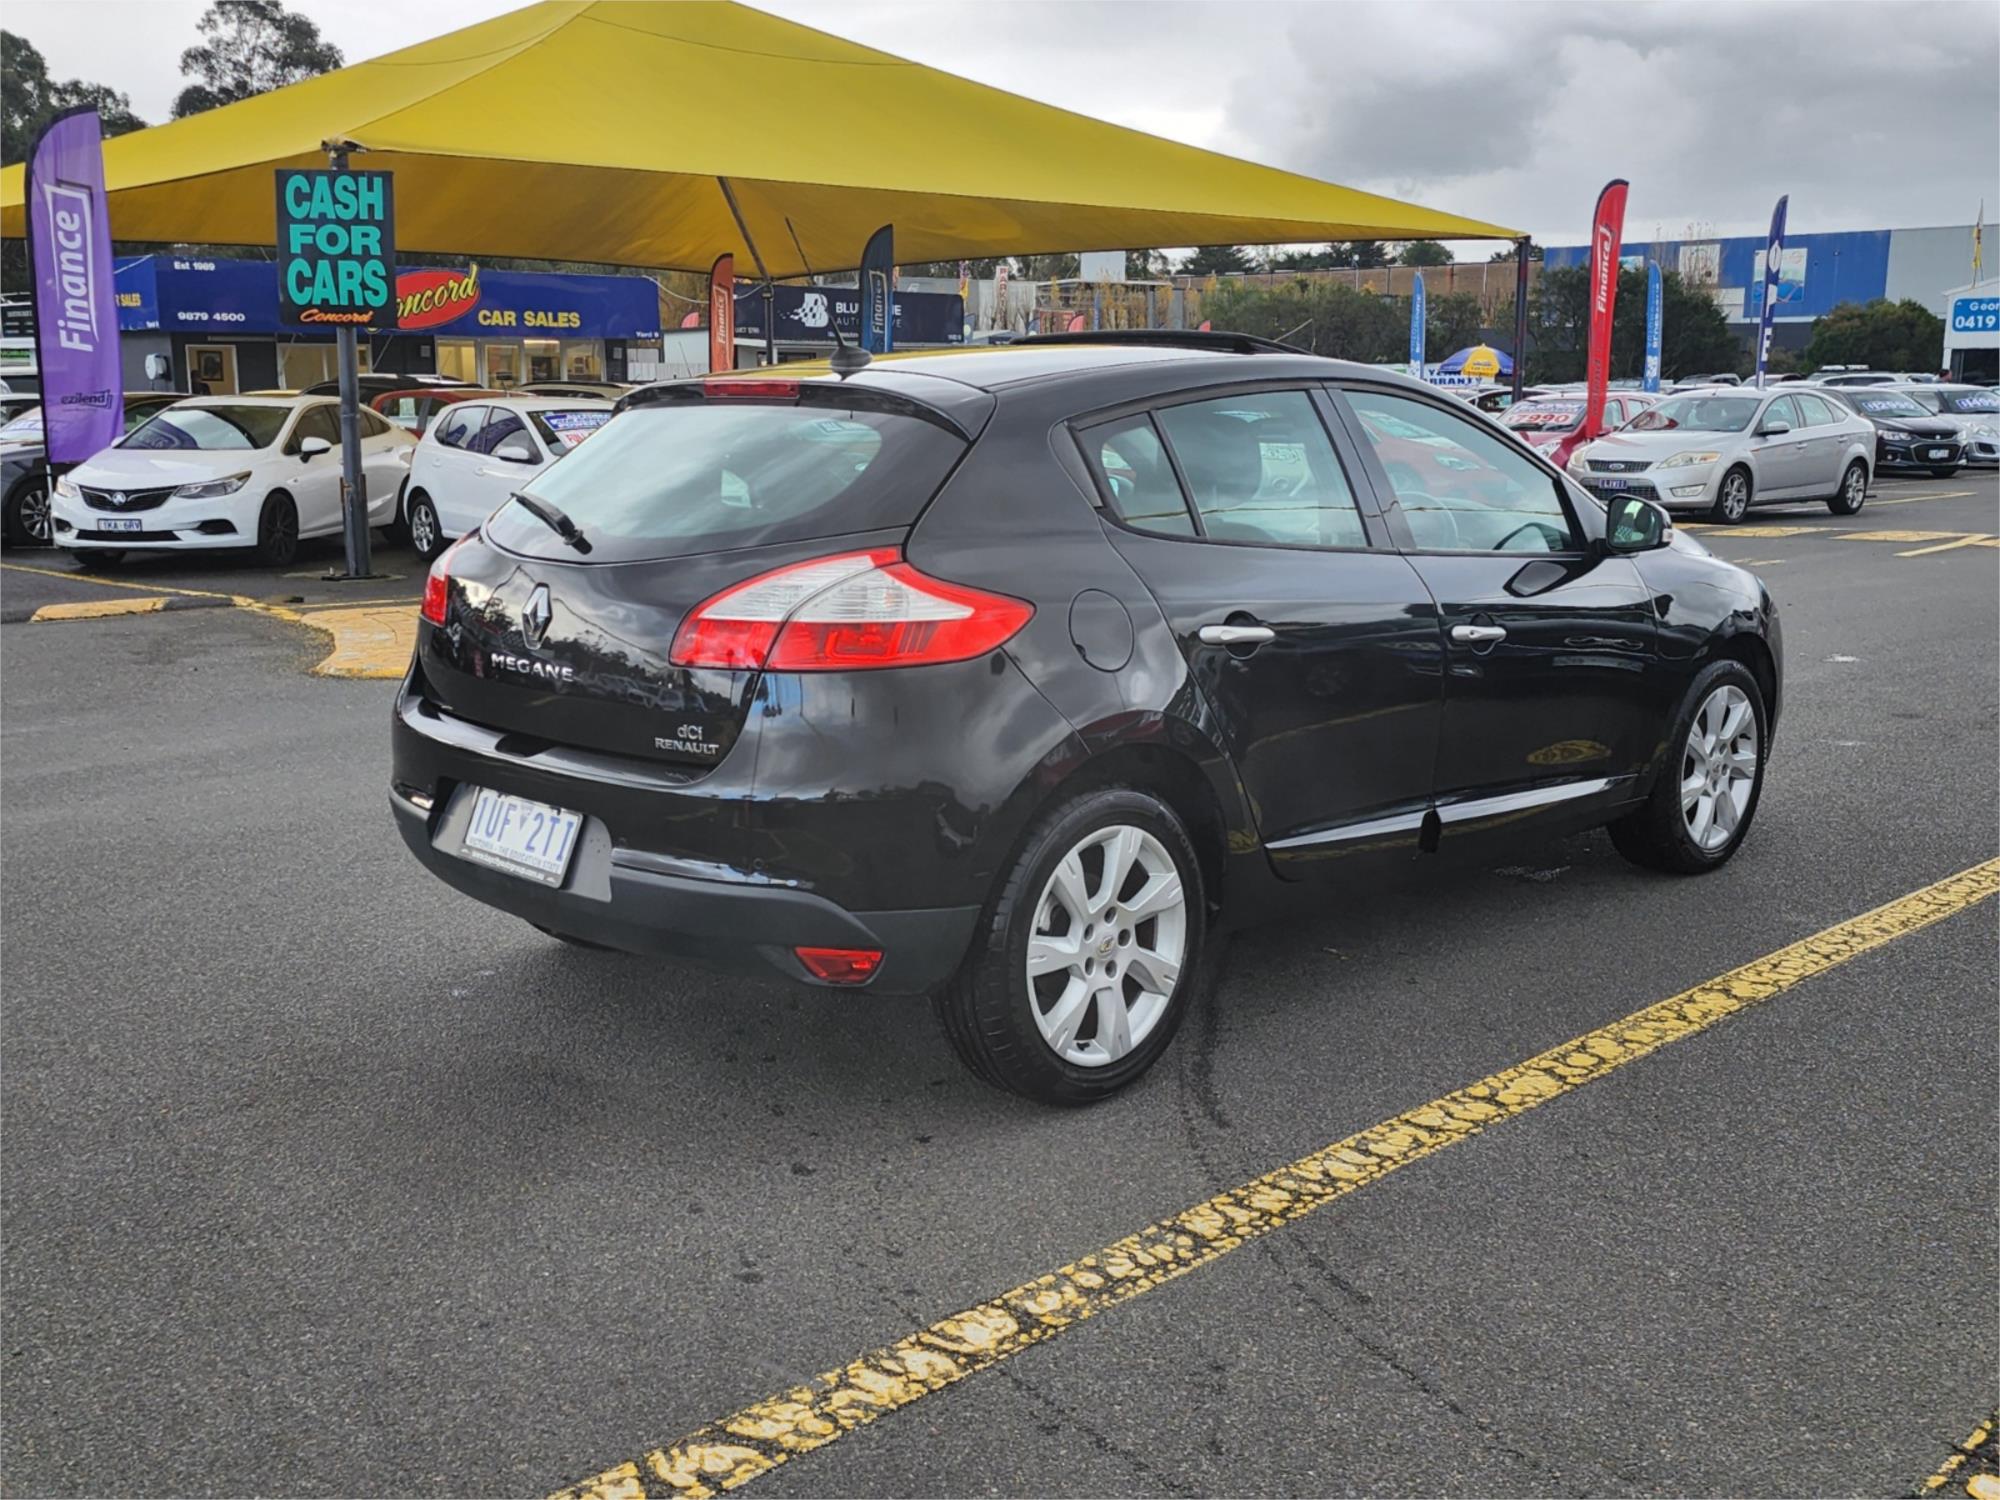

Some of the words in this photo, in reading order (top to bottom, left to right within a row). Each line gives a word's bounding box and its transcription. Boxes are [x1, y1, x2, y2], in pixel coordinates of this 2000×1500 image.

[285, 174, 384, 220] CASH
[289, 223, 382, 256] FOR
[174, 262, 190, 270] Est
[59, 209, 94, 353] Finance
[287, 258, 389, 307] CARS
[1597, 240, 1611, 314] Finance
[177, 312, 209, 321] 9879
[212, 313, 246, 322] 4500
[300, 308, 374, 323] Concord
[835, 302, 860, 315] BLU
[478, 310, 516, 326] CAR
[523, 311, 581, 328] SALES
[1955, 315, 1996, 329] 0419
[491, 653, 574, 682] MEGANE
[677, 723, 704, 740] dCi
[655, 736, 720, 755] RENAULT
[473, 796, 517, 842] 1UF
